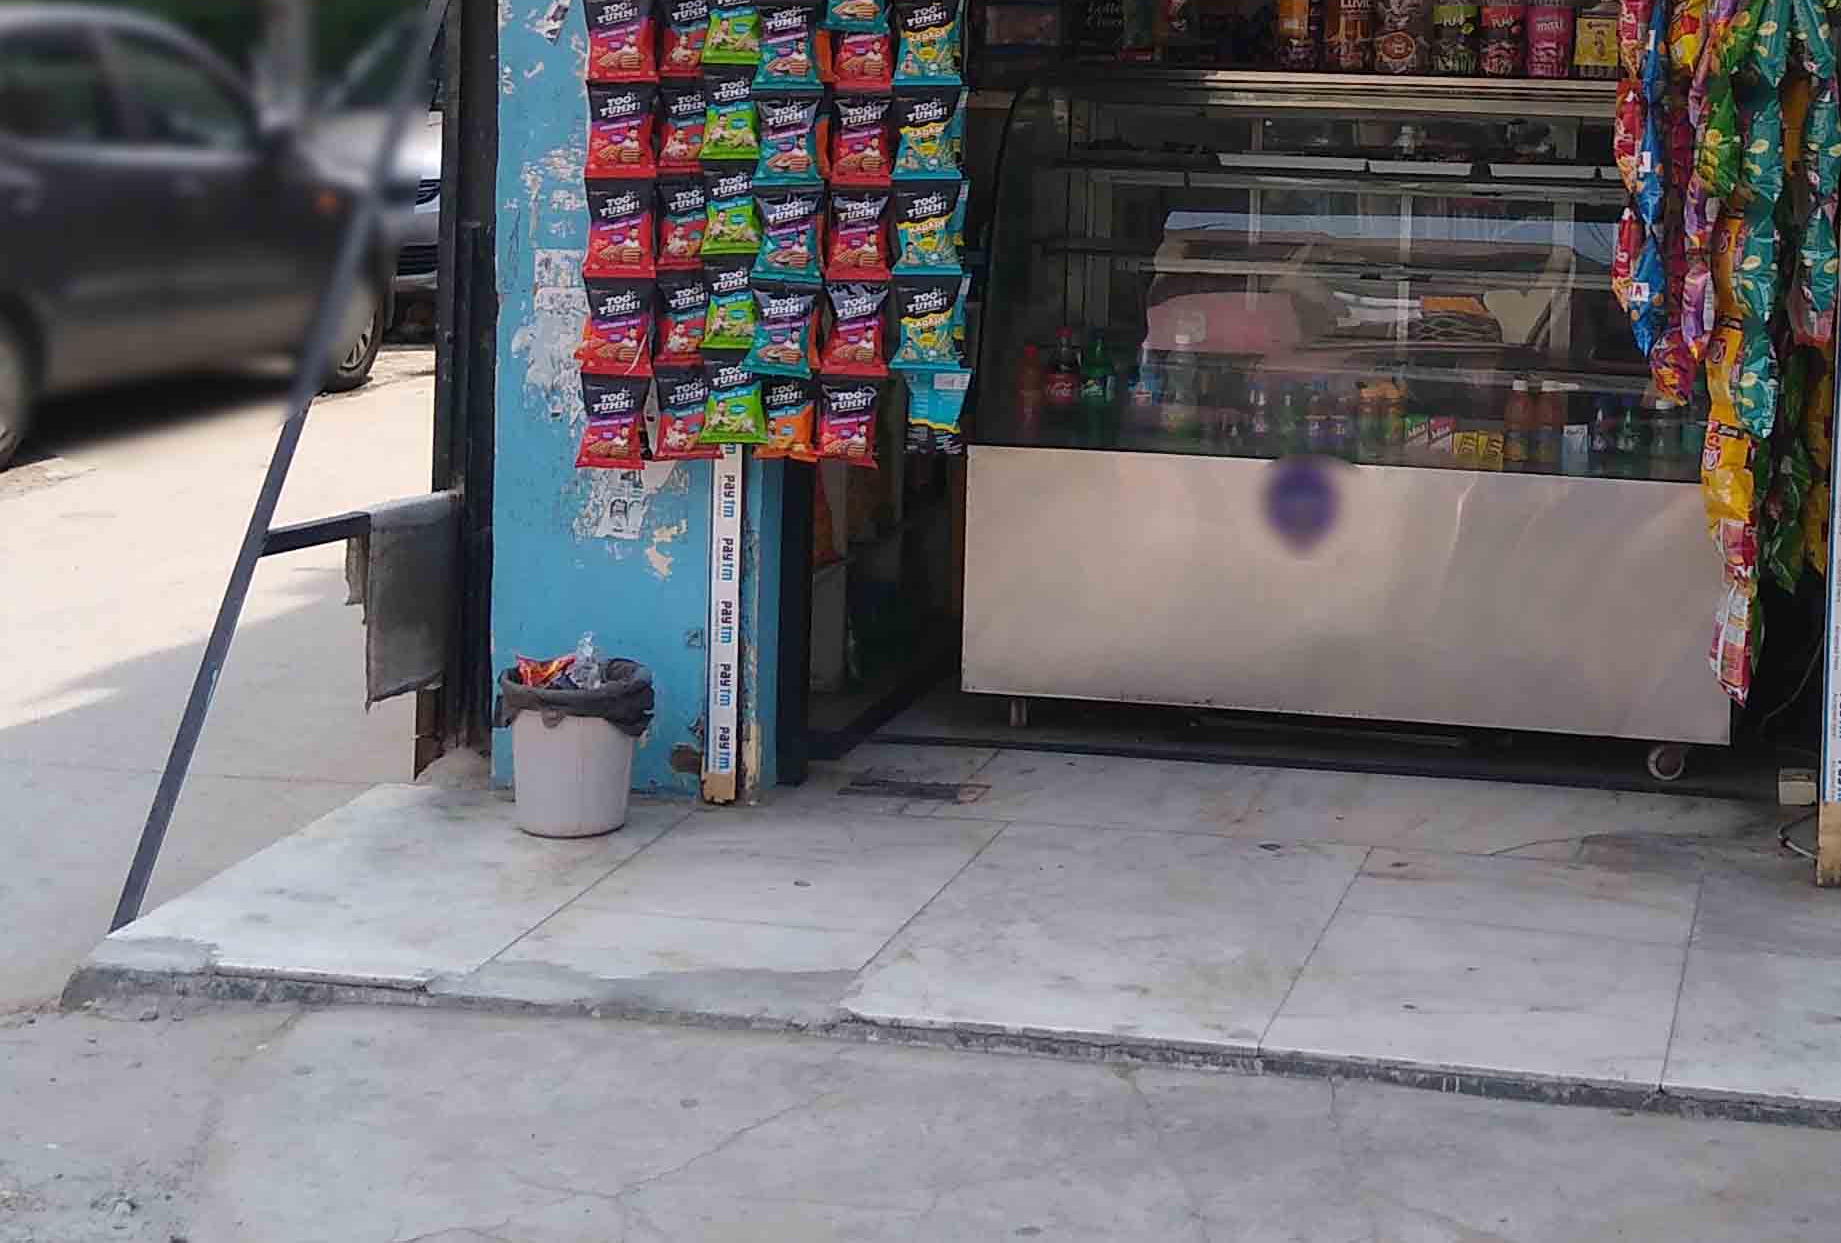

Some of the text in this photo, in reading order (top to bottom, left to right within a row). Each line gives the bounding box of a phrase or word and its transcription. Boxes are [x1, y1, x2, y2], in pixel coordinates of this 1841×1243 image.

[603, 1, 629, 13] TOO
[720, 80, 745, 89] TOO
[607, 95, 631, 105] TOO
[606, 195, 630, 207] TOO
[912, 198, 936, 208] TOO
[720, 270, 744, 280] TOO
[605, 293, 630, 304] TOO
[913, 292, 937, 303] TOO
[600, 392, 625, 402] TOO
[722, 474, 735, 518] Paytm
[721, 538, 734, 581] Paytm
[721, 600, 732, 644] Paytm
[720, 663, 731, 706] Paytm
[719, 726, 730, 769] Paytm
